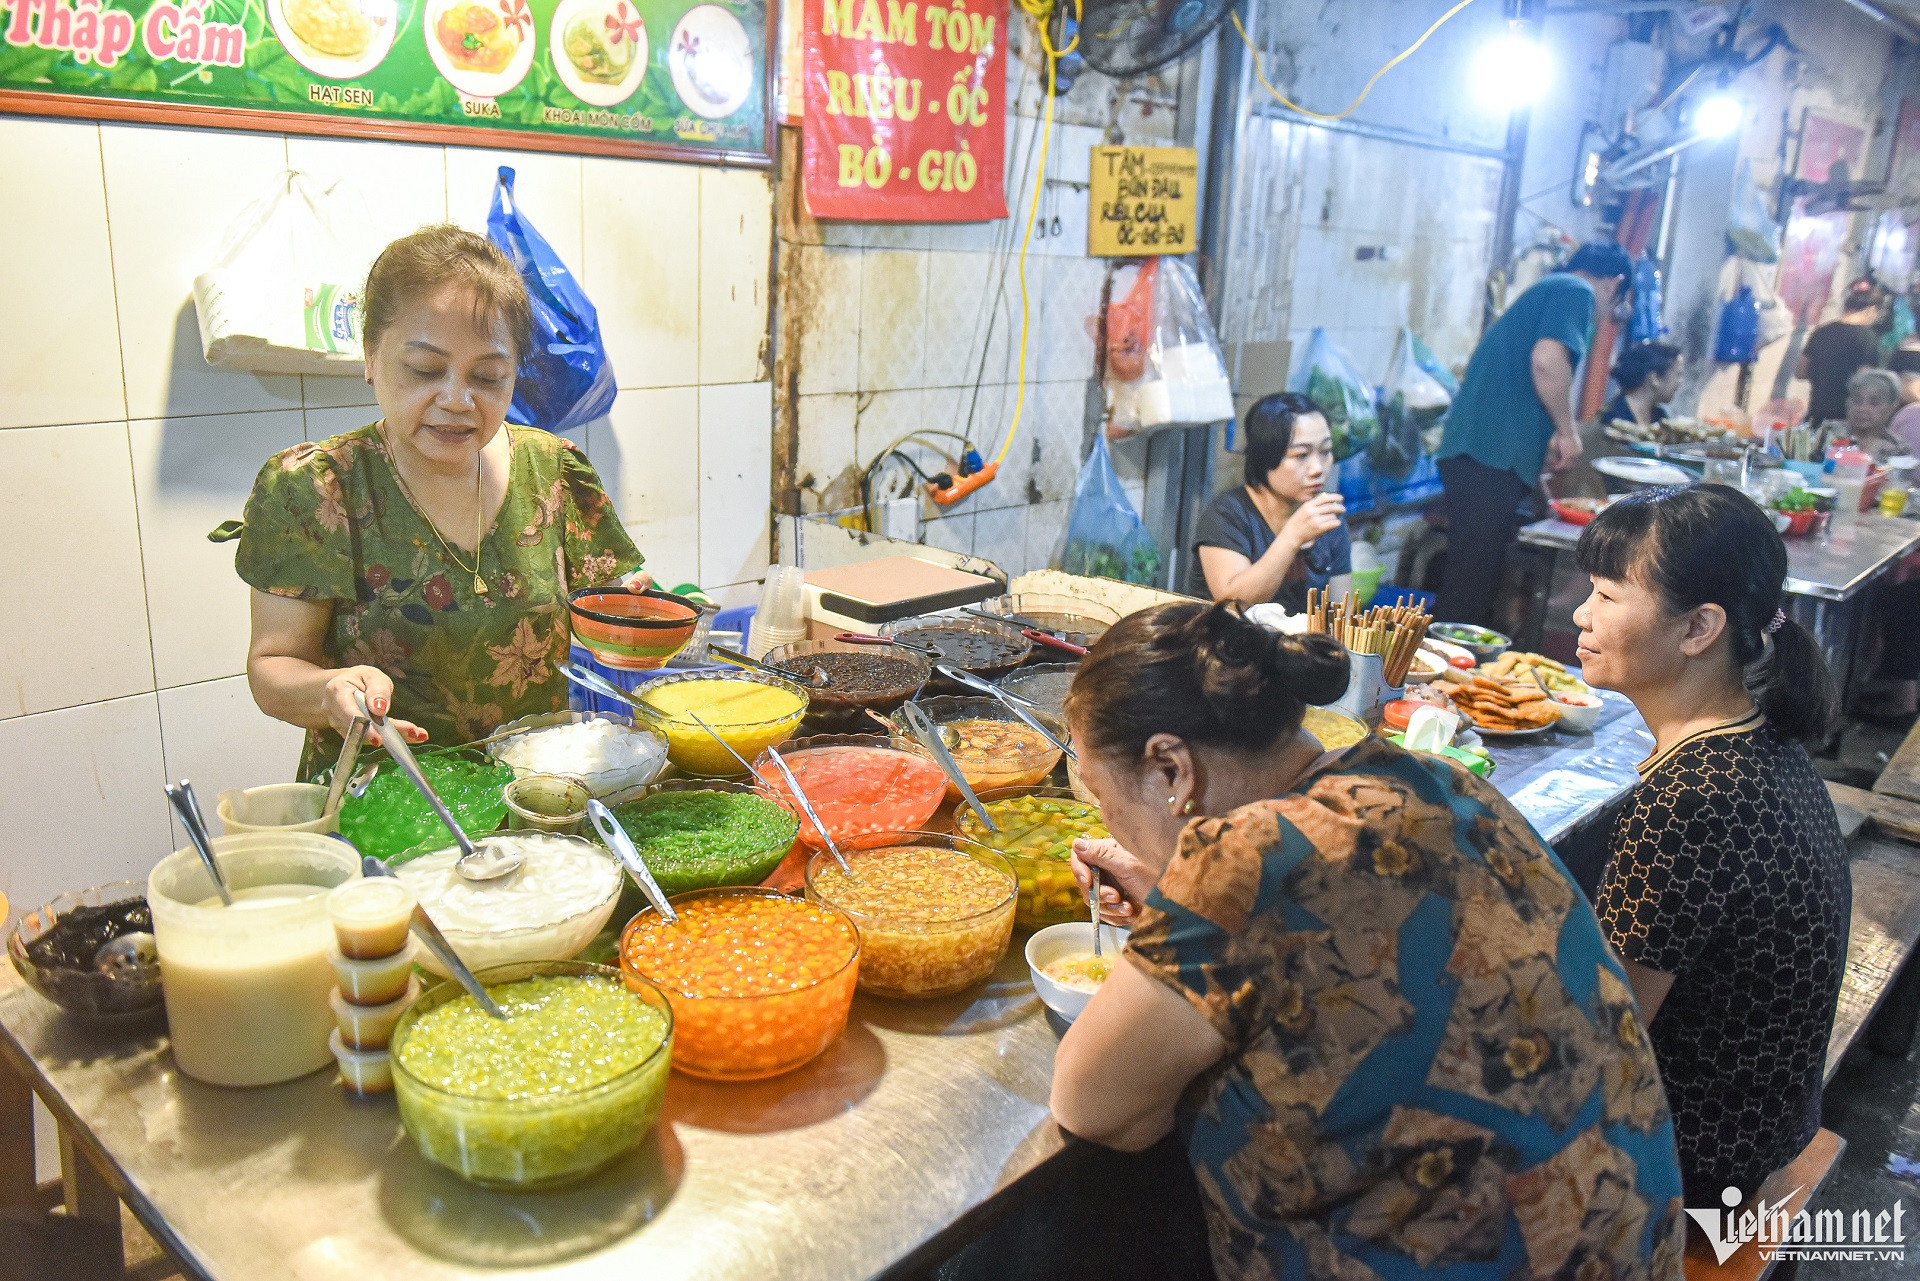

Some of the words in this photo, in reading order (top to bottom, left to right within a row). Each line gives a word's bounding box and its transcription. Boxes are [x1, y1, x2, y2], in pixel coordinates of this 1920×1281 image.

[4, 0, 133, 65] Thập
[925, 0, 996, 57] TÔM
[310, 85, 339, 105] HẠT
[344, 89, 372, 105] SEN
[464, 101, 501, 117] SUKA
[545, 108, 584, 124] KHOAI
[588, 109, 619, 128] MÔN
[826, 62, 922, 122] RIÊU
[946, 65, 989, 127] ỐC
[838, 133, 892, 189] BÒ
[917, 139, 978, 192] GIÒ
